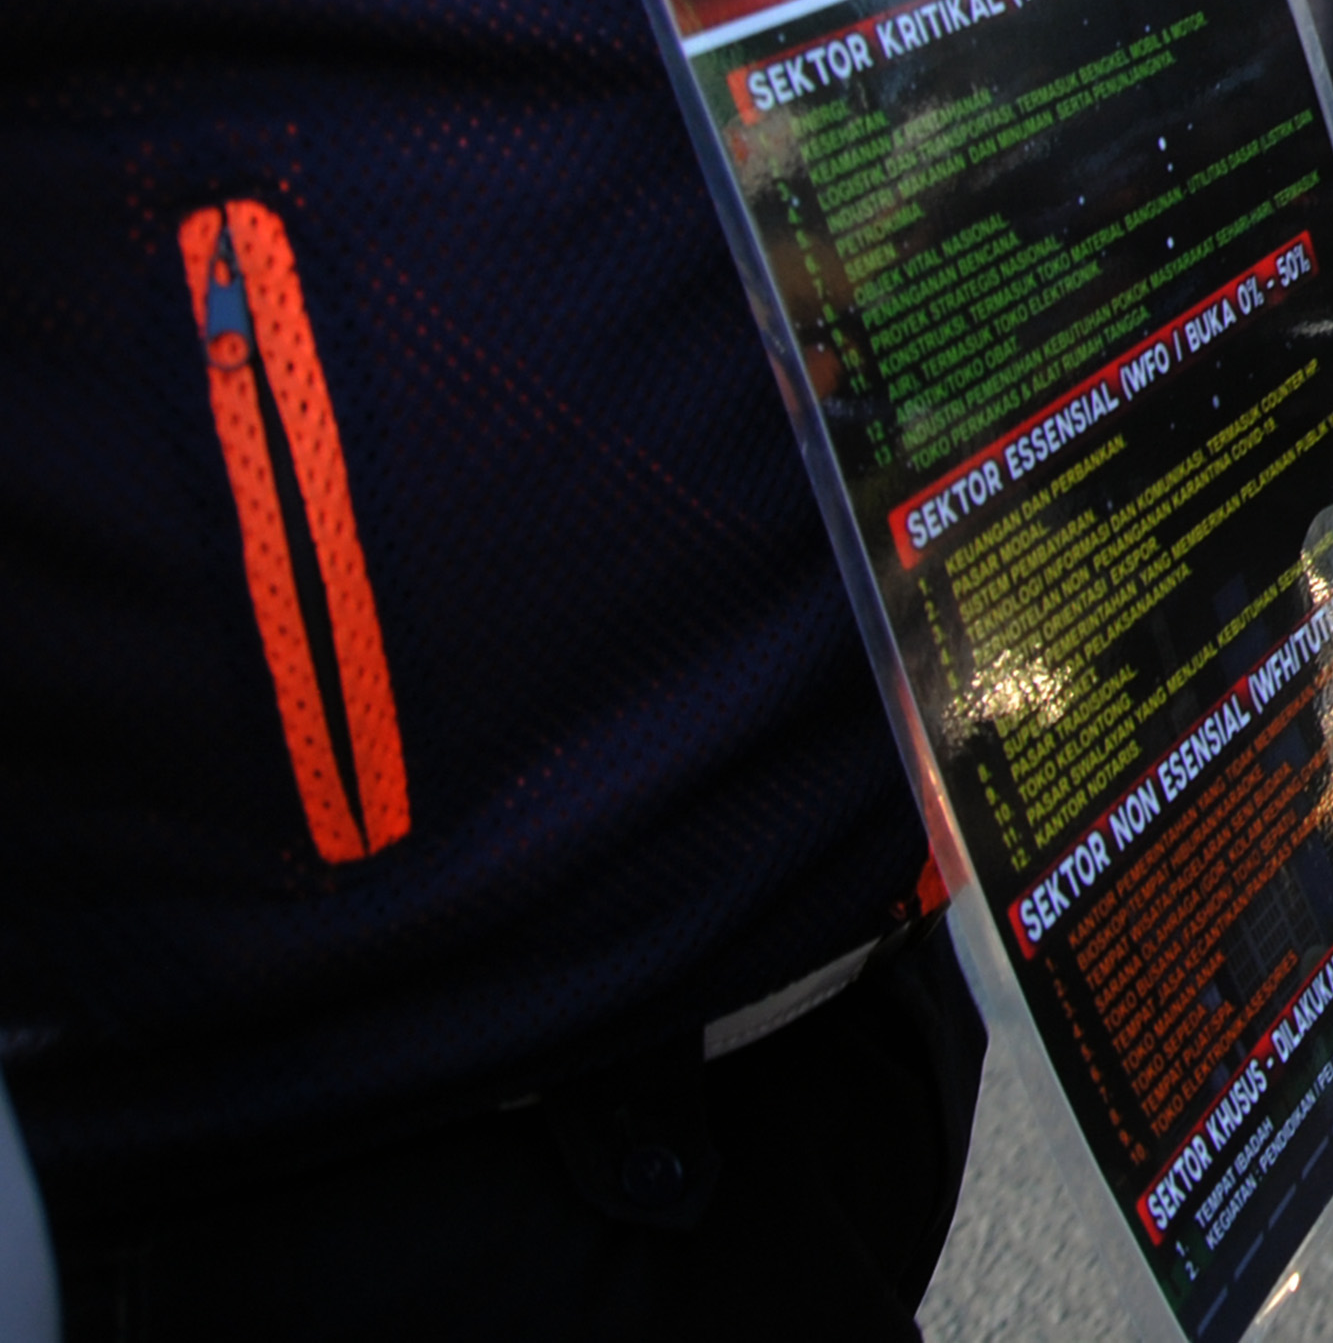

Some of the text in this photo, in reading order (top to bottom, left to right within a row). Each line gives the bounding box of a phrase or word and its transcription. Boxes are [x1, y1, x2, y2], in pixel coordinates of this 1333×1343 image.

[743, 28, 875, 115] SEKTOR
[806, 132, 893, 188] KEAMANAN
[815, 162, 888, 213] LOGISTIK
[883, 147, 919, 180] DAN
[1015, 70, 1081, 116] TERMASUK
[824, 184, 897, 236] INDUSTRI
[896, 150, 968, 200] MAKANAN
[966, 134, 999, 165] DAN
[1053, 87, 1095, 122] SERTA
[851, 265, 905, 309] OBJEK
[901, 244, 943, 282] VITAL
[860, 262, 960, 333] PENANGANAN
[867, 306, 930, 357] PROYEK
[927, 266, 1002, 322] STRATEGIS
[968, 270, 1039, 326] TERMASUK
[1036, 250, 1072, 285] TOKO
[1068, 218, 1126, 266] MATERIAL
[900, 395, 967, 453] INDUSTRI
[963, 346, 1044, 412] PEMENUHAN
[1040, 301, 1113, 362] KEBUTUHAN
[1109, 276, 1152, 317] POKOK
[919, 324, 995, 383] TERMASUK
[992, 302, 1030, 339] TOKO
[903, 240, 1312, 552] SEKTOR ESSENSIAL (WFO BUKA 0% 50%
[909, 432, 952, 475] TOKO
[948, 387, 1022, 449] PERKAKAS
[1029, 359, 1064, 395] ALAT
[1060, 331, 1106, 374] RUMAH
[943, 507, 1023, 579] KEUANGAN
[1019, 486, 1052, 522] DAN
[965, 572, 1045, 647] TEKNOLOGI
[1041, 519, 1112, 587] INFORMASI
[1108, 499, 1138, 534] DAN
[1205, 401, 1263, 458] TERMASUK
[971, 585, 1063, 670] PERHOTELAN
[1060, 563, 1091, 599] NON
[1091, 497, 1173, 574] PENANGANAN
[1170, 450, 1233, 511] KARANTINA
[949, 551, 1002, 603] PASAR
[957, 570, 1012, 626] SISTEM
[1041, 575, 1109, 642] ORIENTASI
[1042, 577, 1139, 669] PEMERINTAHAN
[1138, 548, 1173, 589] YANG
[1169, 491, 1242, 563] MEMBERIKAN
[1009, 730, 1057, 784] PASAR
[1024, 774, 1072, 829] PASAR
[1068, 713, 1137, 788] SWALAYAN
[1133, 684, 1168, 728] YANG
[1165, 637, 1219, 698] MENJUAL
[1215, 581, 1280, 651] KEBUTUHAN
[1016, 825, 1113, 948] SEKTOR
[1107, 775, 1163, 856] NON
[1155, 685, 1253, 807] ESENSIAL
[1017, 759, 1057, 807] TOKO
[1033, 787, 1089, 851] KANTOR
[1066, 887, 1118, 951] KANTOR
[1114, 802, 1200, 901] PEMERINTAHAN
[1196, 773, 1227, 816] YANG
[1085, 932, 1131, 992] TEMPAT
[1092, 949, 1144, 1016] SARANA
[1139, 885, 1202, 964] OLAHRAGA
[1102, 986, 1138, 1036] TOKO
[1134, 935, 1183, 1000] BUSANA
[1231, 846, 1262, 889] TOKO
[1111, 962, 1186, 1059] TEMPAT JASA
[1121, 945, 1227, 1079] TOKO MAINAN ANAK
[1130, 997, 1209, 1100] TOKO SEPEDA
[1140, 1057, 1185, 1121] TEMPAT
[1149, 1089, 1185, 1143] TOKO
[1145, 1126, 1214, 1236] SEKTOR
[1204, 1053, 1270, 1158] KHUSUS
[1193, 1112, 1276, 1235] TEMPAT IBADAH
[1203, 1168, 1258, 1253] KEGIATAN
[1258, 1087, 1317, 1177] PENDIDIKAN
